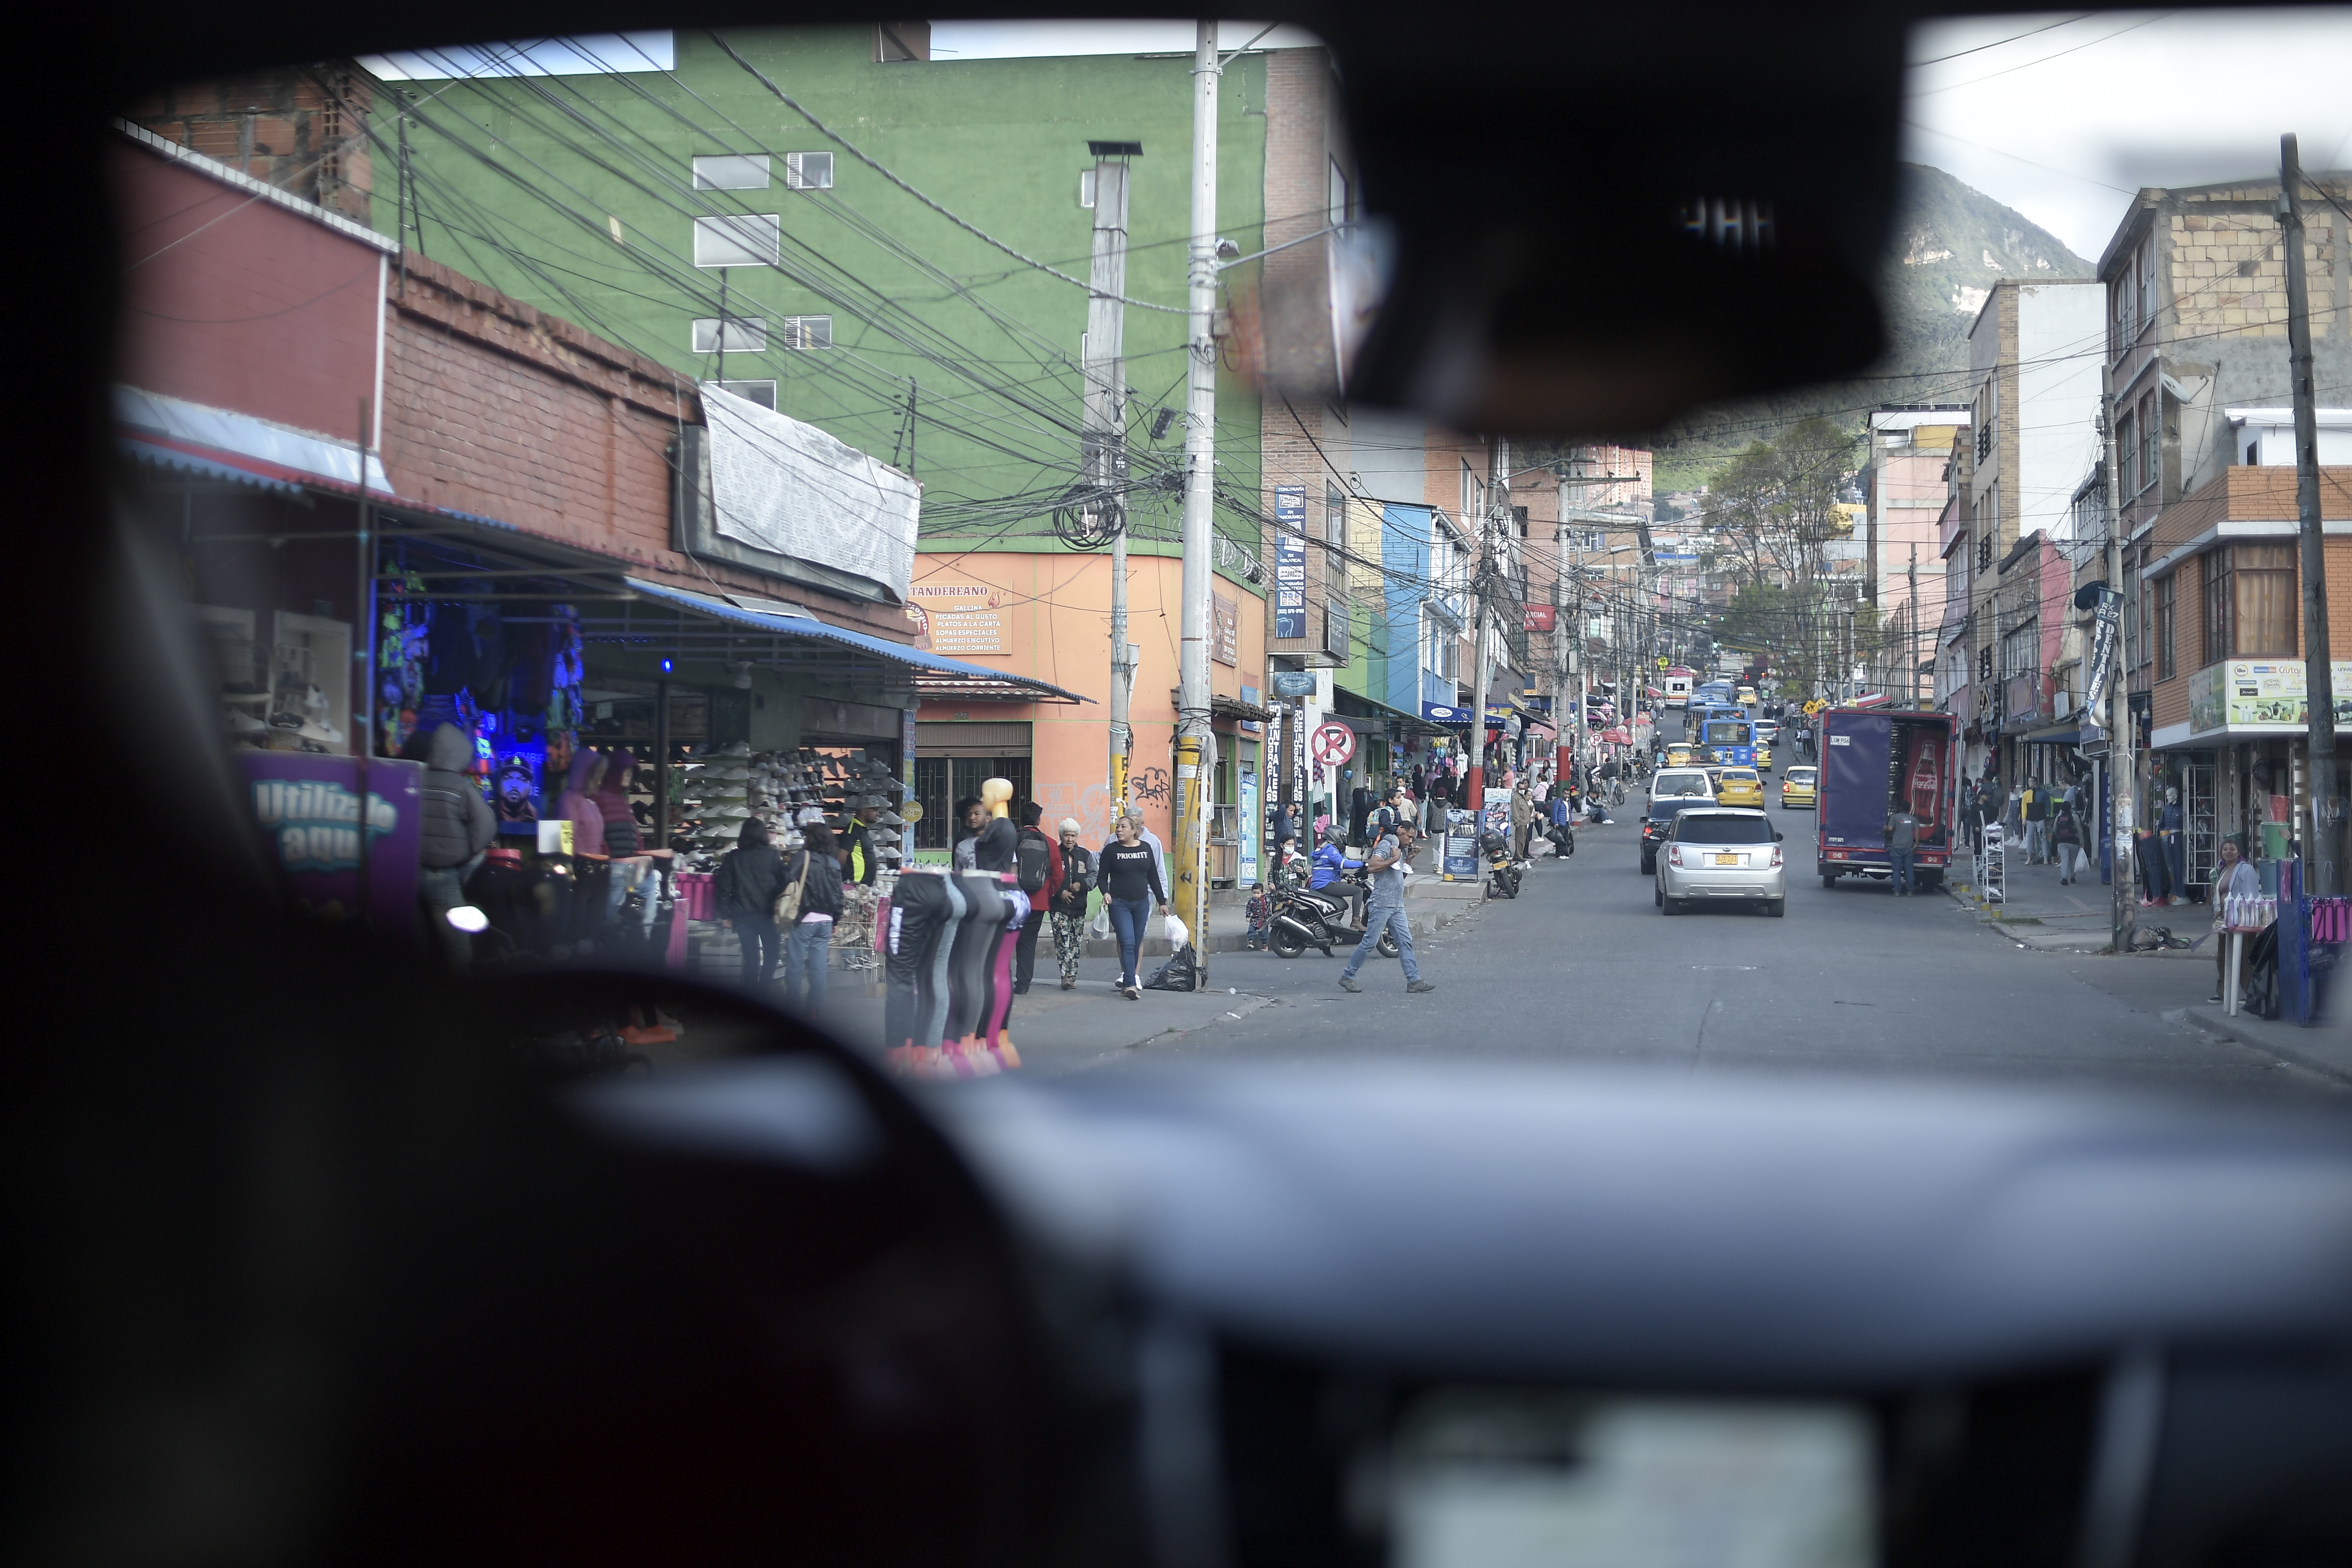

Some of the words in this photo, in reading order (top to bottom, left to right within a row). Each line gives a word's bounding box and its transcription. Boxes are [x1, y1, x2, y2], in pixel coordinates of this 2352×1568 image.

[908, 586, 988, 596] TANDEREANO
[2102, 602, 2114, 611] RX
[2088, 622, 2115, 700] DENTALES
[1266, 705, 1274, 802] RDIOGRAFIAS
[1272, 705, 1280, 802] DENTALES
[282, 826, 362, 863] aqu
